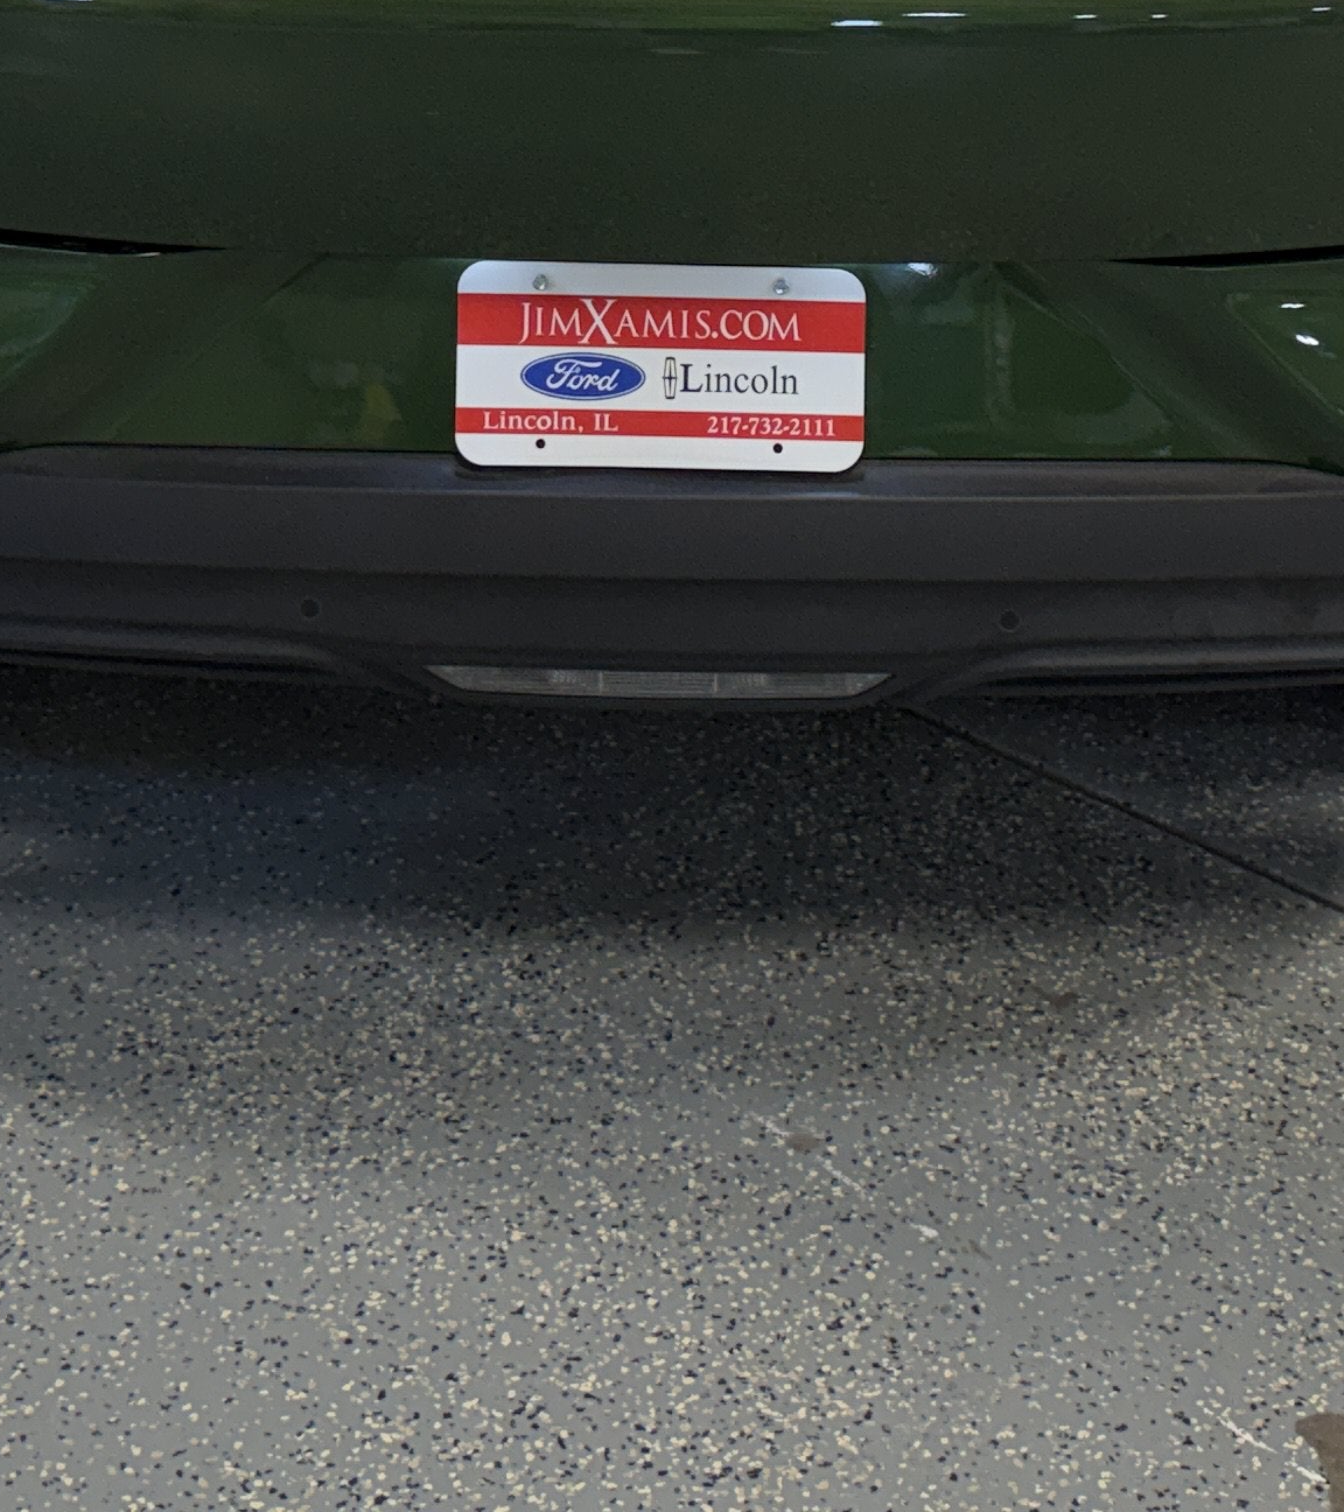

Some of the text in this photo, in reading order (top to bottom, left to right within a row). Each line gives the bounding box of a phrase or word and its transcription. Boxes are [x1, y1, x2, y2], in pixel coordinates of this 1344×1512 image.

[546, 358, 622, 392] Ford
[679, 363, 799, 396] Lincoln
[482, 410, 619, 433] Lincoln, IL
[706, 416, 836, 437] 217-732-2111
